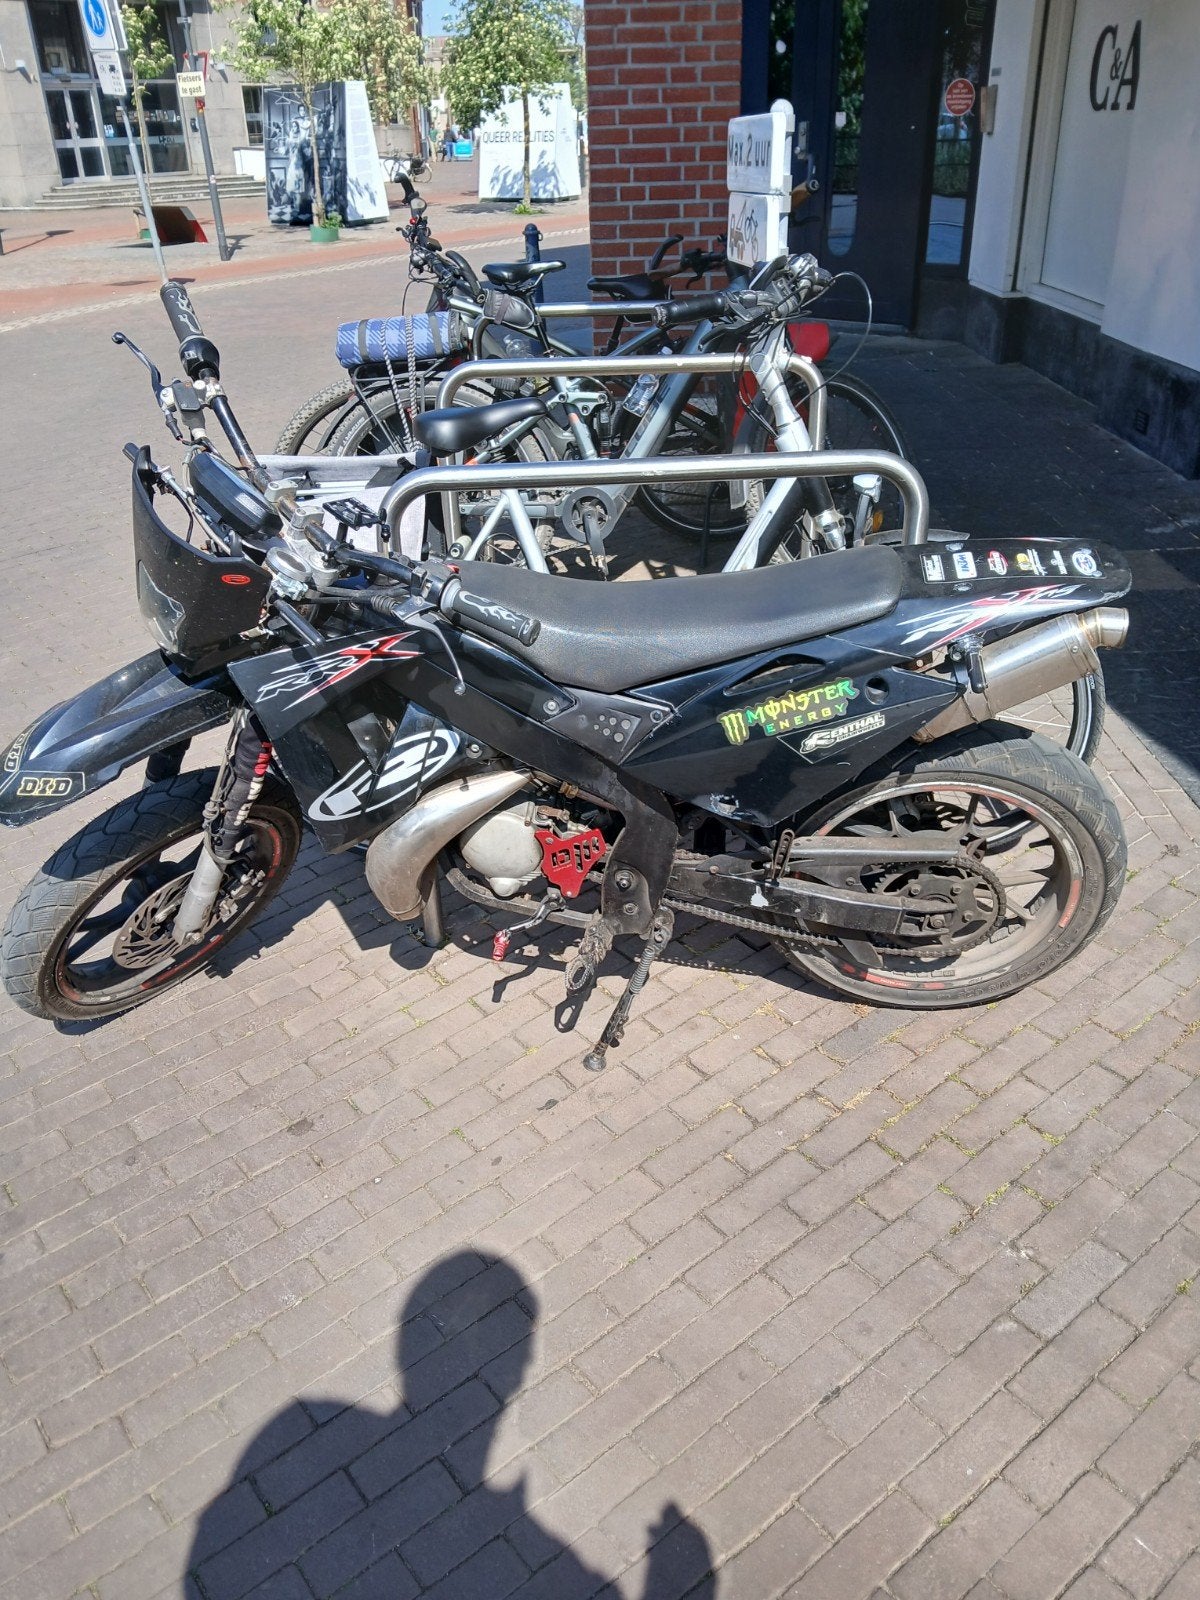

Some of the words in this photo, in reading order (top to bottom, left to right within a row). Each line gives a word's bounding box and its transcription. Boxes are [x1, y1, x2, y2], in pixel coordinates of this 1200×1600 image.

[1090, 19, 1142, 112] C&A
[178, 74, 202, 83] Fietsers
[189, 85, 202, 95] gast
[483, 131, 511, 143] QUEER
[747, 132, 752, 167] 2
[755, 140, 771, 167] uur
[746, 680, 856, 724] MONSTER
[766, 703, 846, 734] ENERGY
[17, 777, 73, 796] DID
